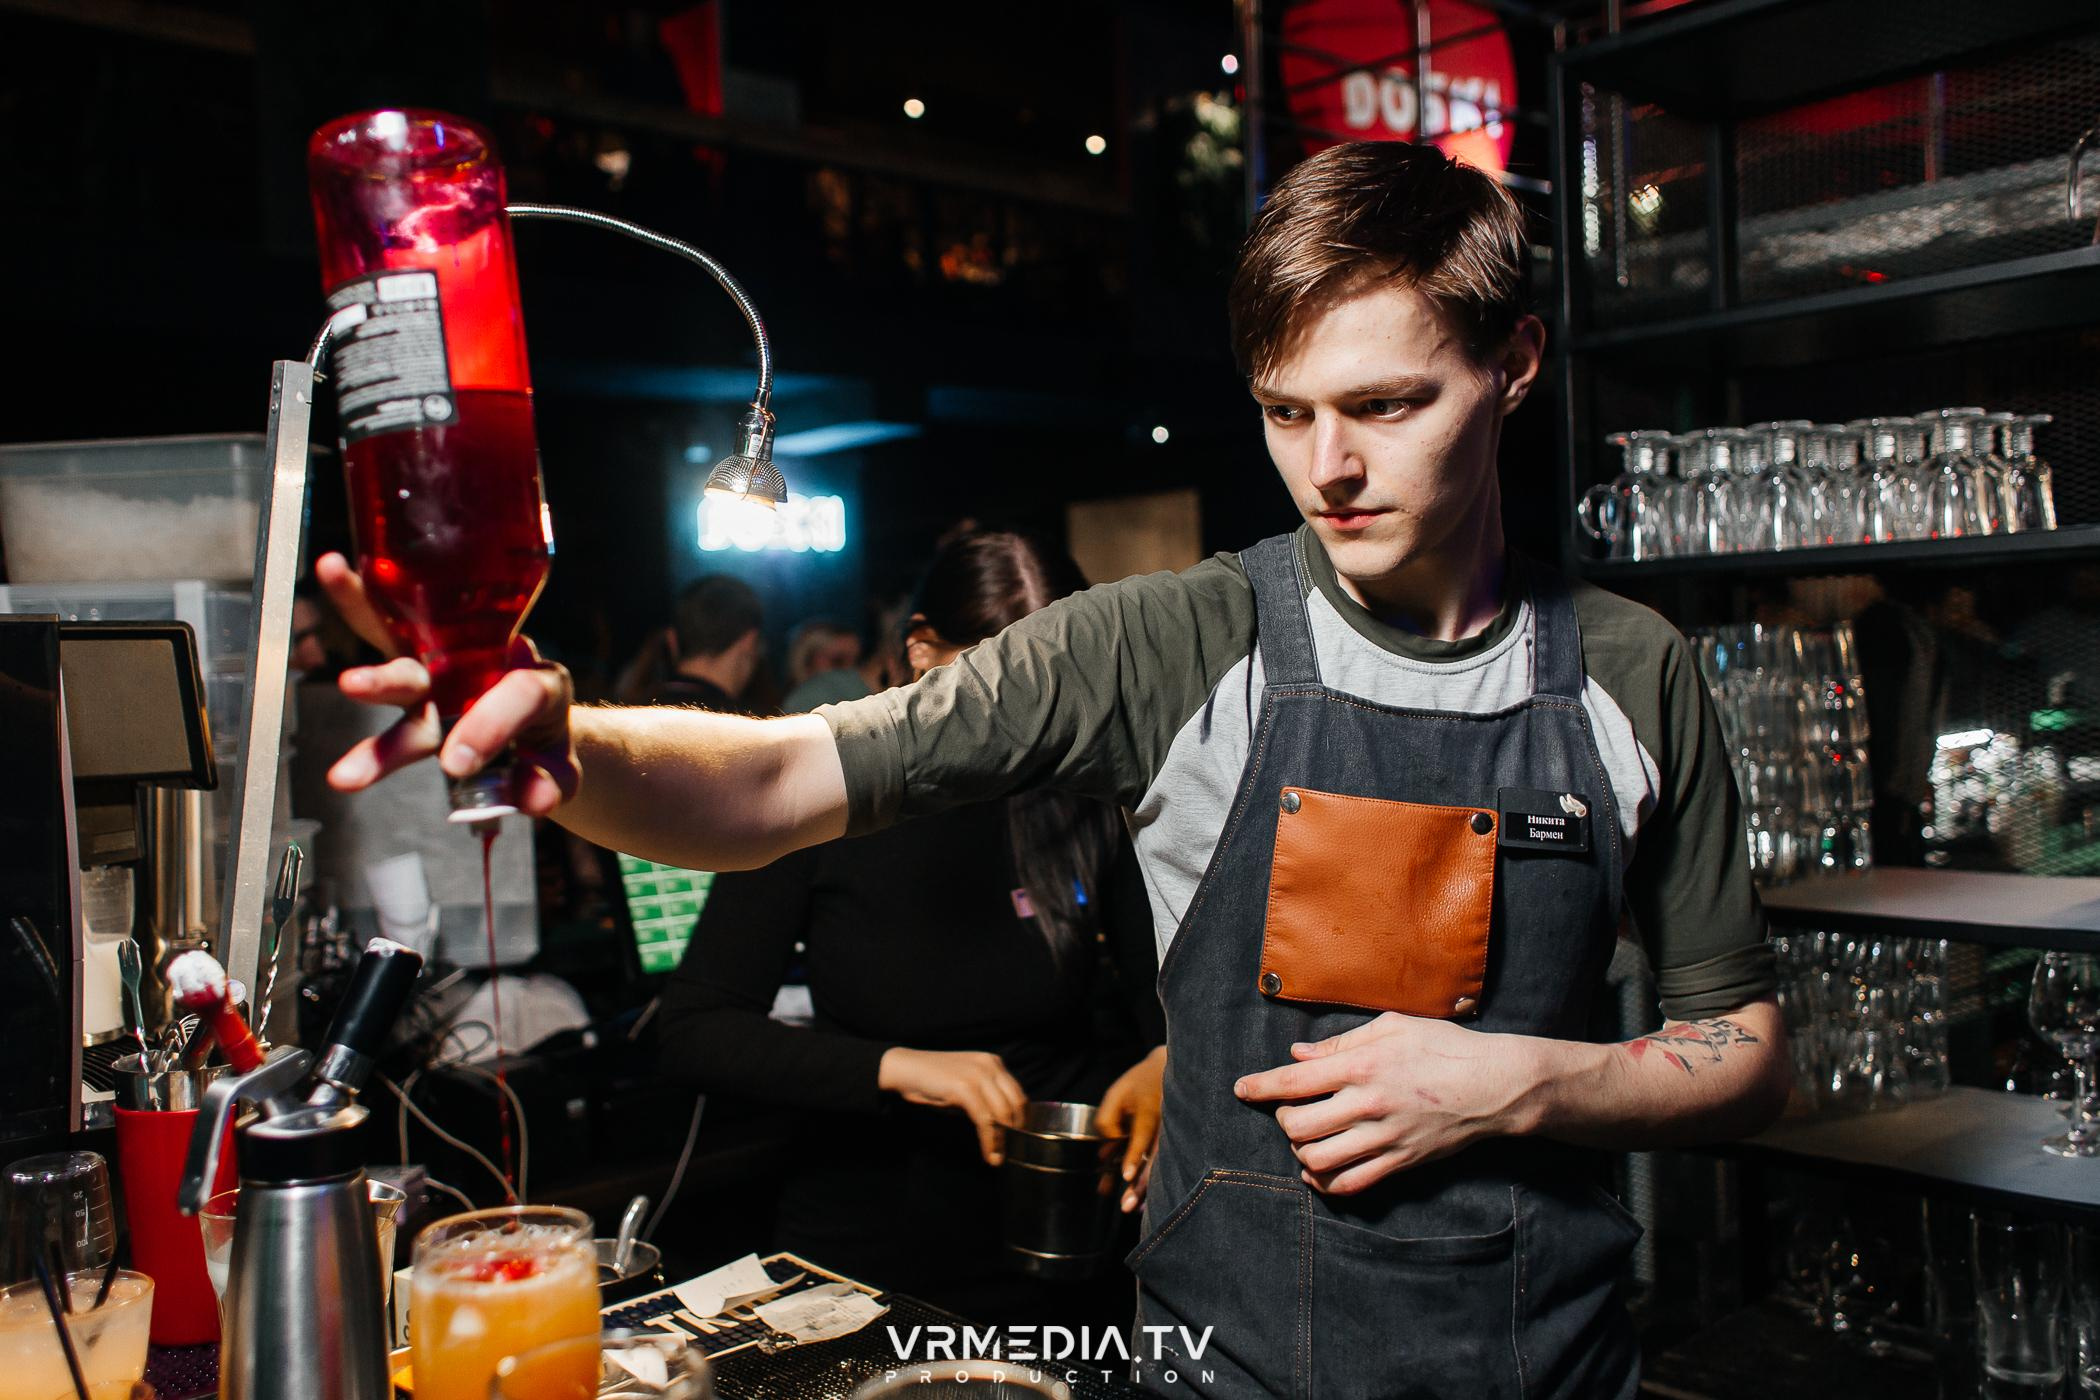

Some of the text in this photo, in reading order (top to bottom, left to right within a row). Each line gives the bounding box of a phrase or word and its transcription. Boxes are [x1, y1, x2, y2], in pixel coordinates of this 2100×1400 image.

[1528, 815, 1565, 826] Никита
[1529, 828, 1563, 840] Бармен
[75, 1209, 85, 1218] 50
